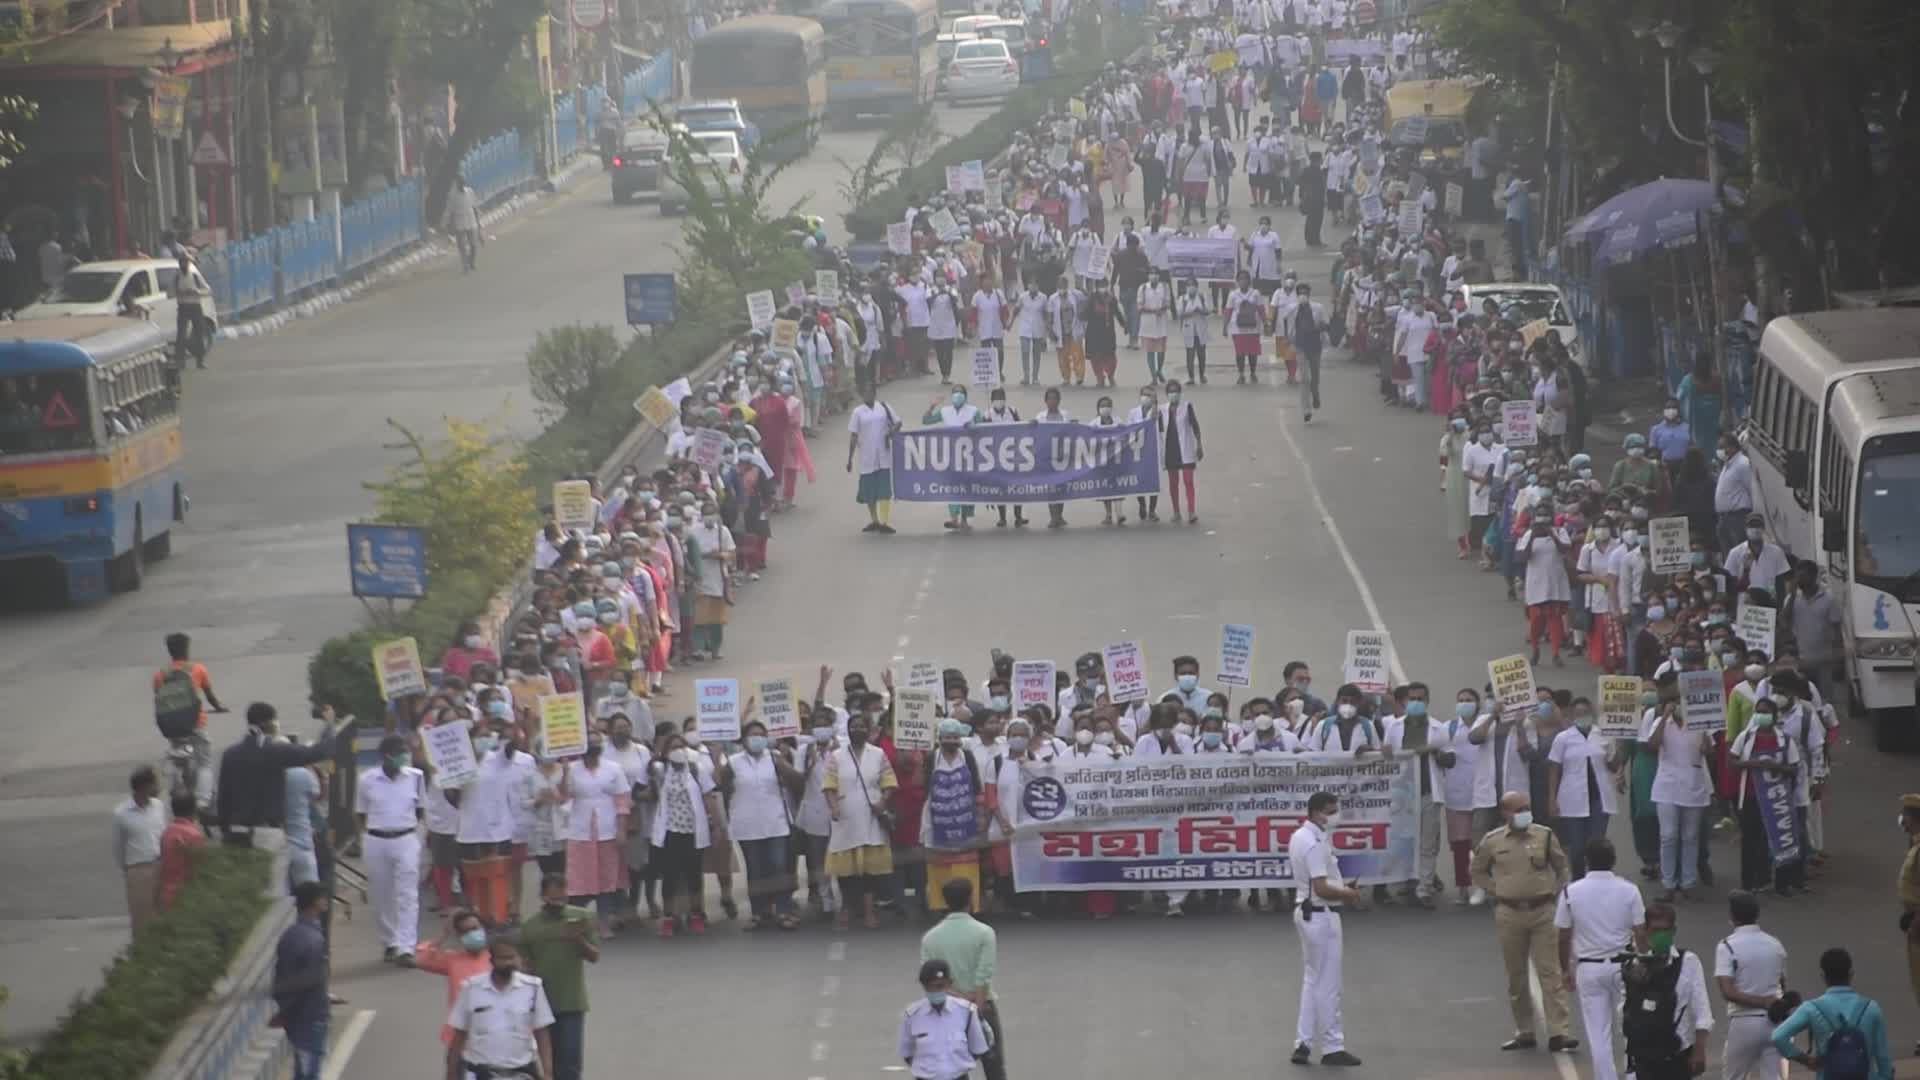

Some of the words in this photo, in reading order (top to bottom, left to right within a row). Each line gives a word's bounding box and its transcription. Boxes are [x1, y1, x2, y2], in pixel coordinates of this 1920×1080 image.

[903, 435, 1036, 473] NURSES
[1050, 428, 1145, 472] UNITY
[912, 482, 926, 495] 9,
[929, 482, 967, 495] Creek
[971, 482, 1003, 496] Row,
[1117, 475, 1139, 488] WB
[1355, 635, 1384, 646] EQUAL
[1356, 647, 1381, 657] WORK
[1354, 658, 1383, 668] EQUAL
[1494, 659, 1525, 674] CALLED
[1359, 670, 1376, 679] PAY
[1496, 676, 1503, 685] A
[1603, 681, 1636, 690] CALLED
[704, 685, 730, 697] STOP
[761, 680, 790, 693] EQUAL
[1503, 692, 1530, 705] ZERO
[1604, 693, 1610, 701] A
[1687, 693, 1720, 705] SALARY
[701, 702, 735, 713] SALARY
[763, 703, 792, 715] EQUAL
[769, 715, 785, 725] PAY
[898, 720, 931, 729] EQUAL
[1607, 715, 1633, 724] ZERO
[904, 729, 923, 737] PAY
[1038, 828, 1163, 858] মহা
